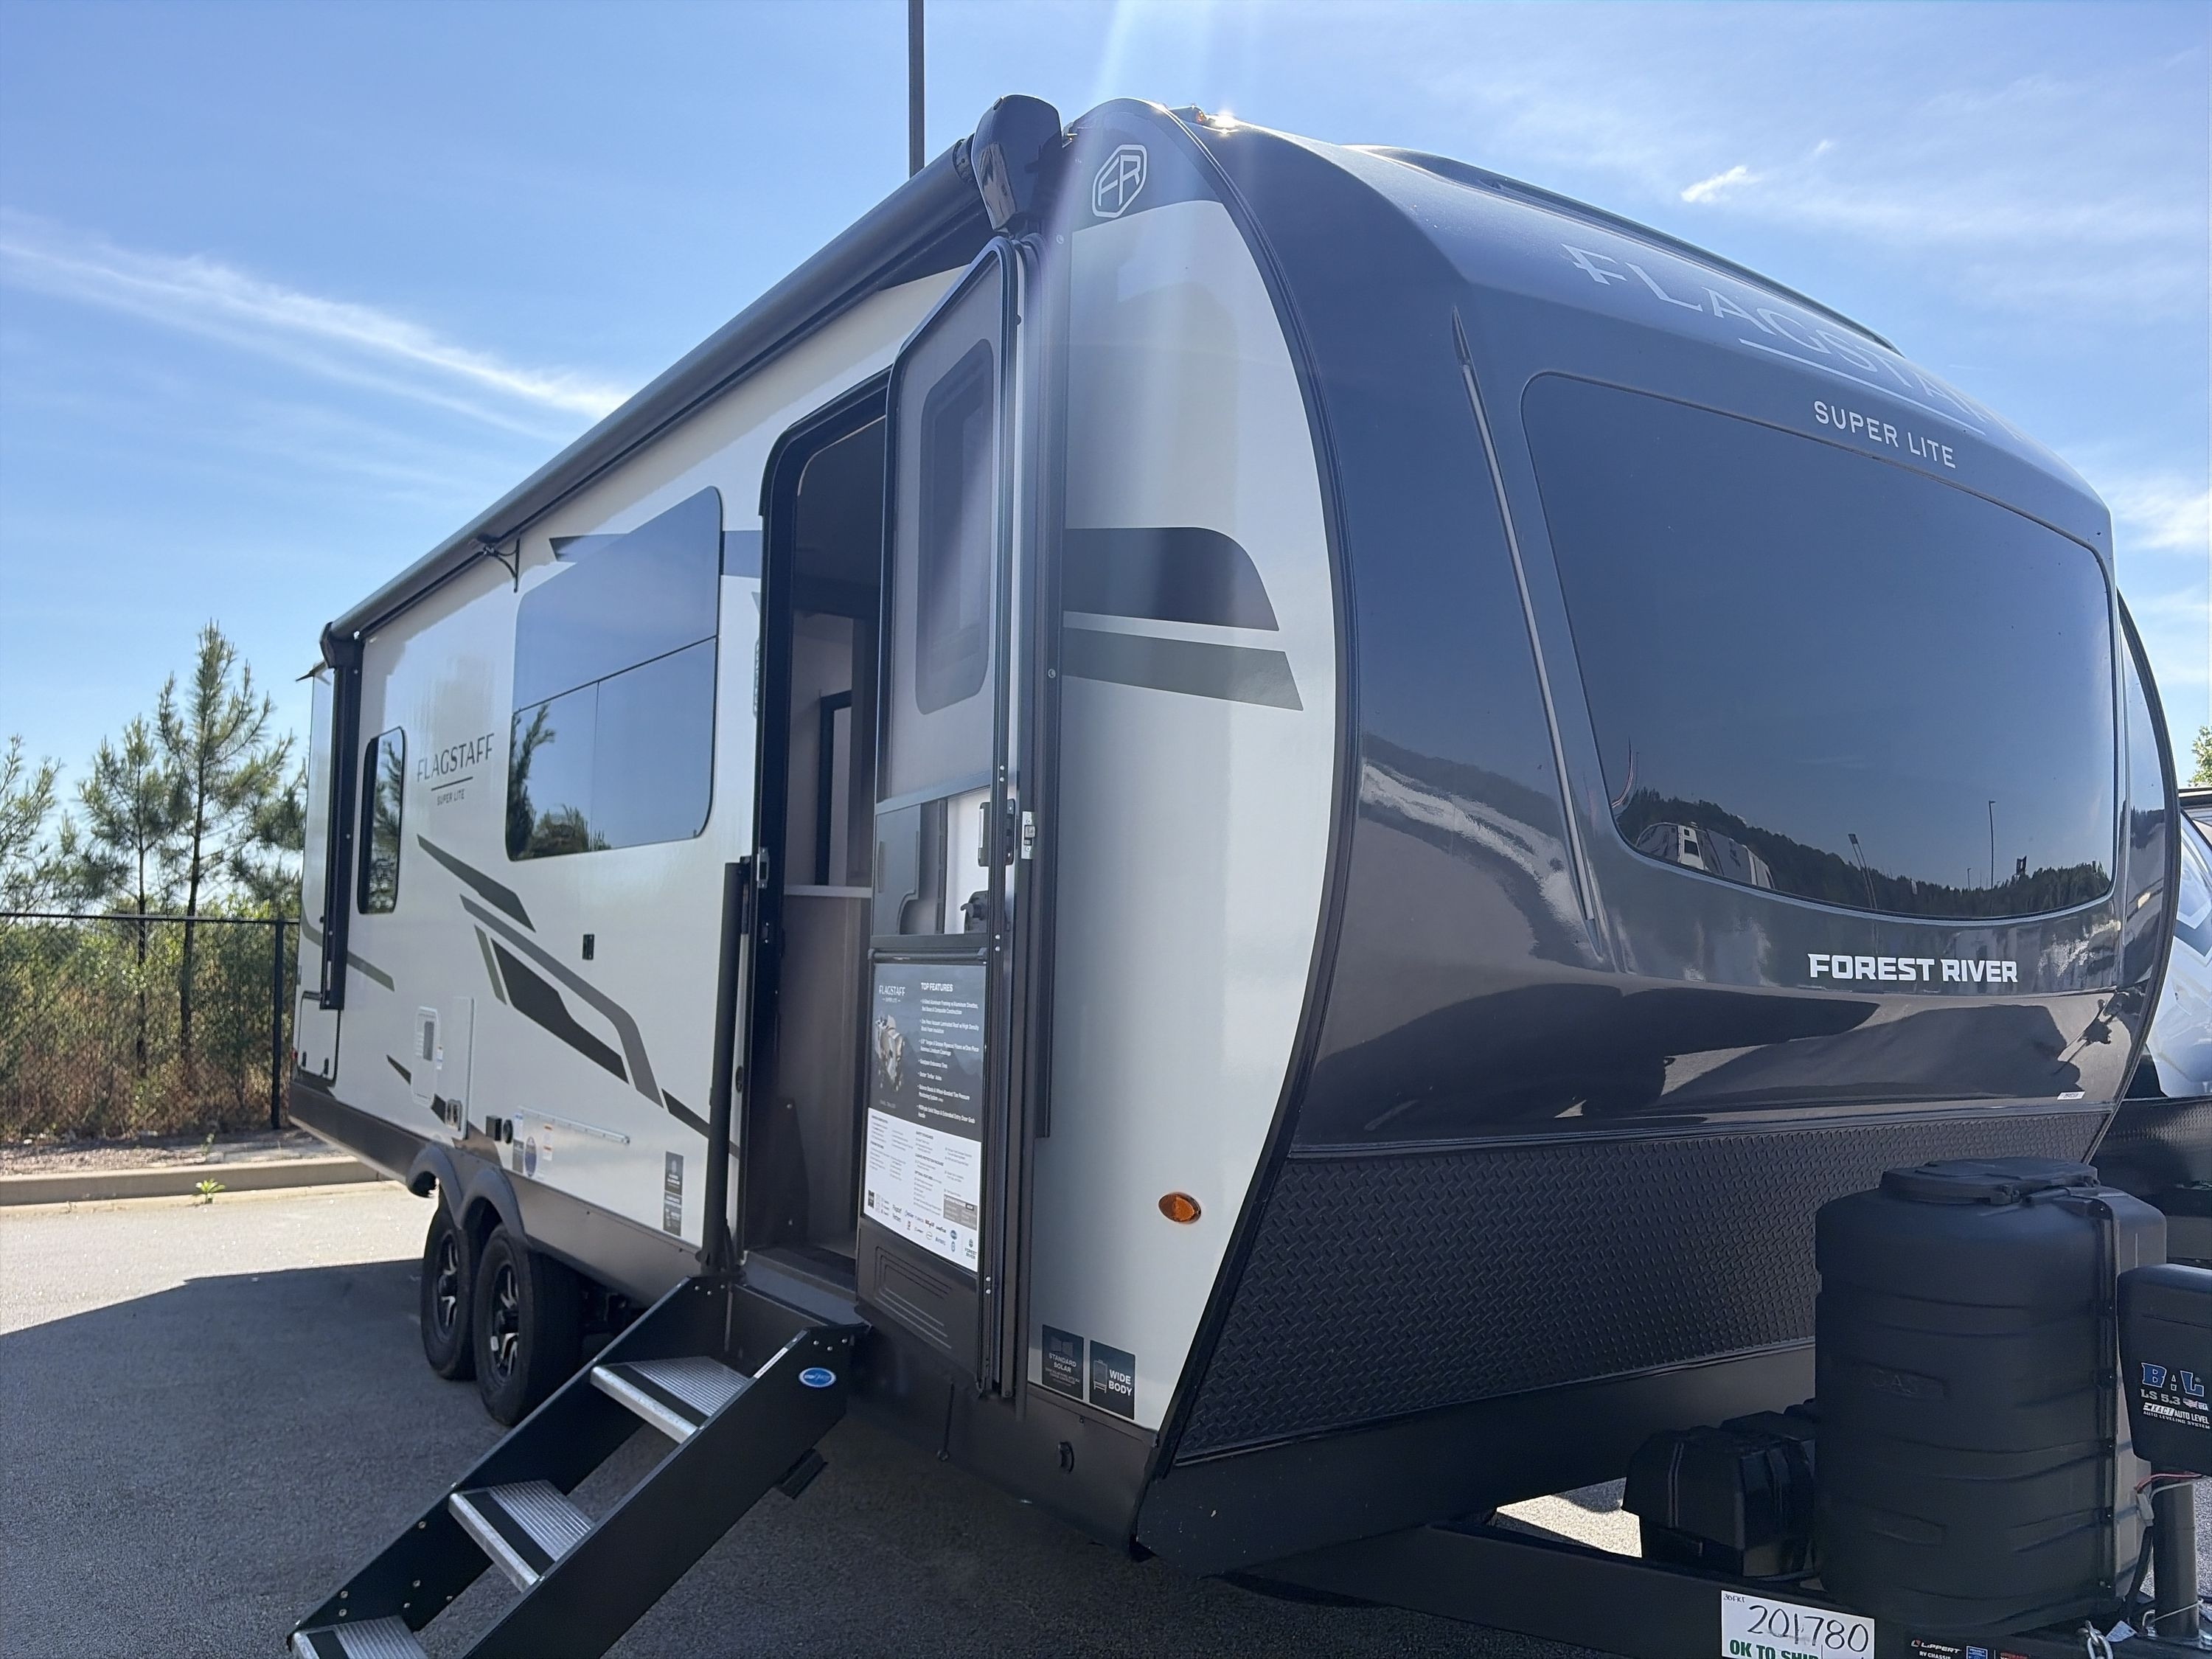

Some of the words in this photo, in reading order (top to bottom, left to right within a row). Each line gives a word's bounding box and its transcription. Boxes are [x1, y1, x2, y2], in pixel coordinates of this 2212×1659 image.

[1814, 400, 1899, 448] SUPER
[1907, 431, 1955, 469] LITE
[417, 732, 495, 782] FLAGSTAFF
[453, 789, 465, 801] LITE
[1807, 953, 1935, 981] FOREST
[1940, 959, 2018, 983] RIVER
[878, 985, 906, 996] FLAGSTAFF
[921, 982, 930, 991] TOP
[930, 983, 953, 992] FEATURES
[1048, 1352, 1077, 1368] STANDARD
[1054, 1362, 1071, 1374] SOLAR
[1109, 1369, 1131, 1385] WIDE
[1108, 1381, 1133, 1397] BODY
[2140, 1388, 2157, 1400] LS
[2160, 1393, 2180, 1405] 5.3
[2198, 1402, 2208, 1411] USA
[2160, 1414, 2185, 1425] LEVELING
[2187, 1420, 2211, 1430] SYSTEM
[2174, 1410, 2190, 1420] AUTO
[2191, 1413, 2210, 1425] LEVEL
[1747, 1604, 1869, 1653] 201780
[1729, 1639, 1752, 1658] OK
[1756, 1644, 1776, 1659] TO
[1781, 1650, 1819, 1659] SH
[1921, 1642, 1962, 1654] LIPPERT
